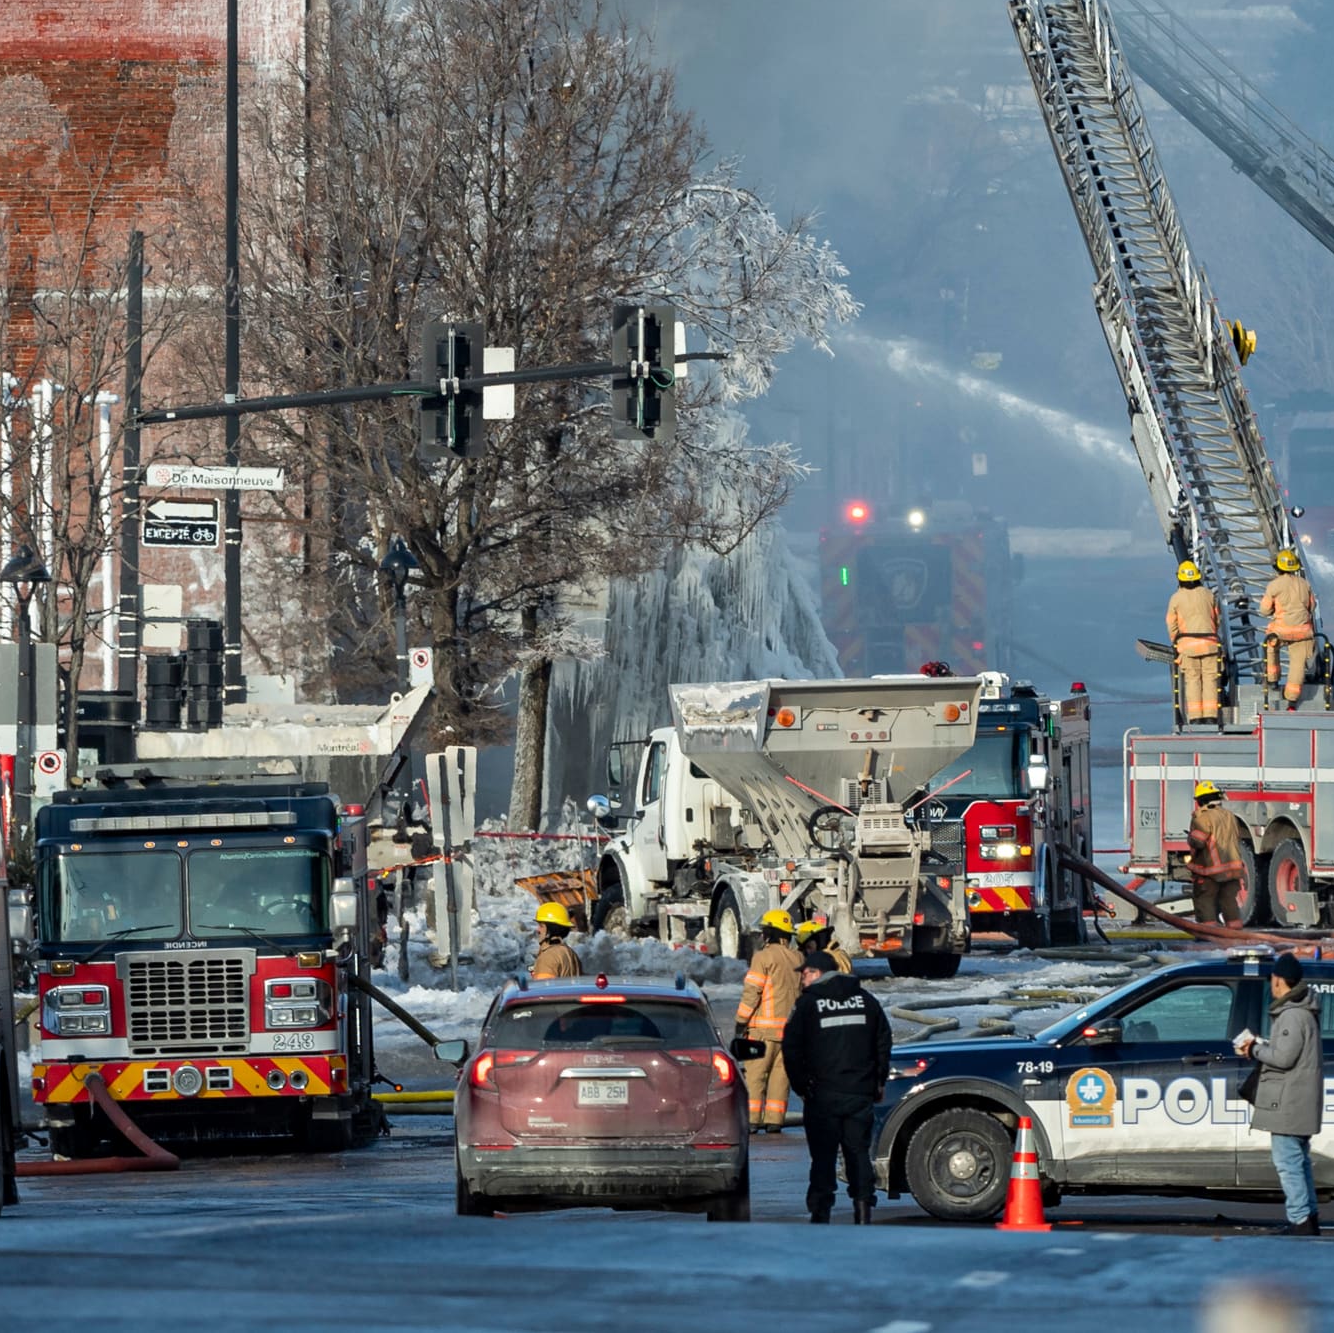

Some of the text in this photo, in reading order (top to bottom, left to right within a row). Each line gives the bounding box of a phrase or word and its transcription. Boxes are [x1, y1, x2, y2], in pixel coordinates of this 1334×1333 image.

[171, 472, 274, 487] De Maisonneuve
[145, 525, 190, 541] EXCEPTÉ
[816, 995, 865, 1013] POLICE
[273, 1033, 315, 1050] 243
[1016, 1061, 1054, 1074] 78-19
